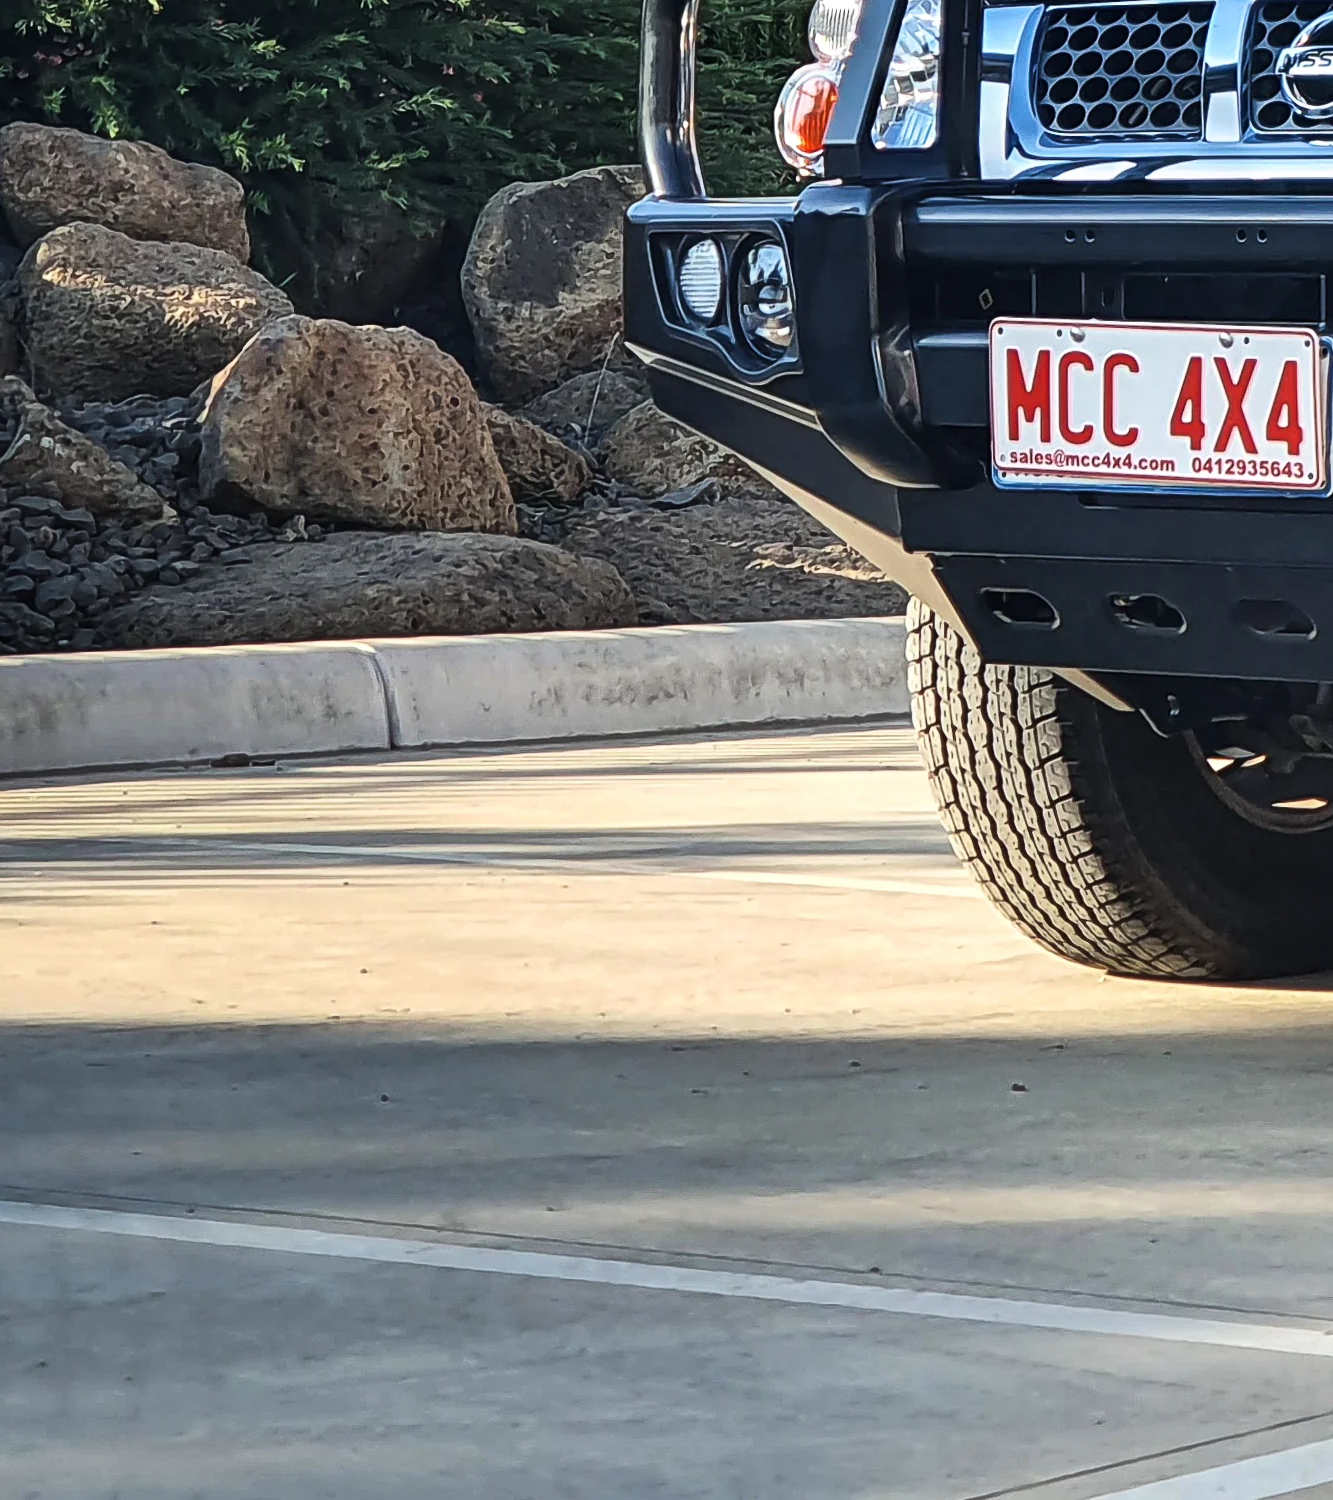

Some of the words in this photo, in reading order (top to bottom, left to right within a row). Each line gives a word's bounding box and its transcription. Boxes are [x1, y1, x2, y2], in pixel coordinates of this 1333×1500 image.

[1006, 348, 1141, 448] MCC
[1169, 355, 1305, 456] 4X4
[1010, 448, 1176, 472] sales@mcc4x4.com
[1191, 457, 1305, 479] 0412935643
